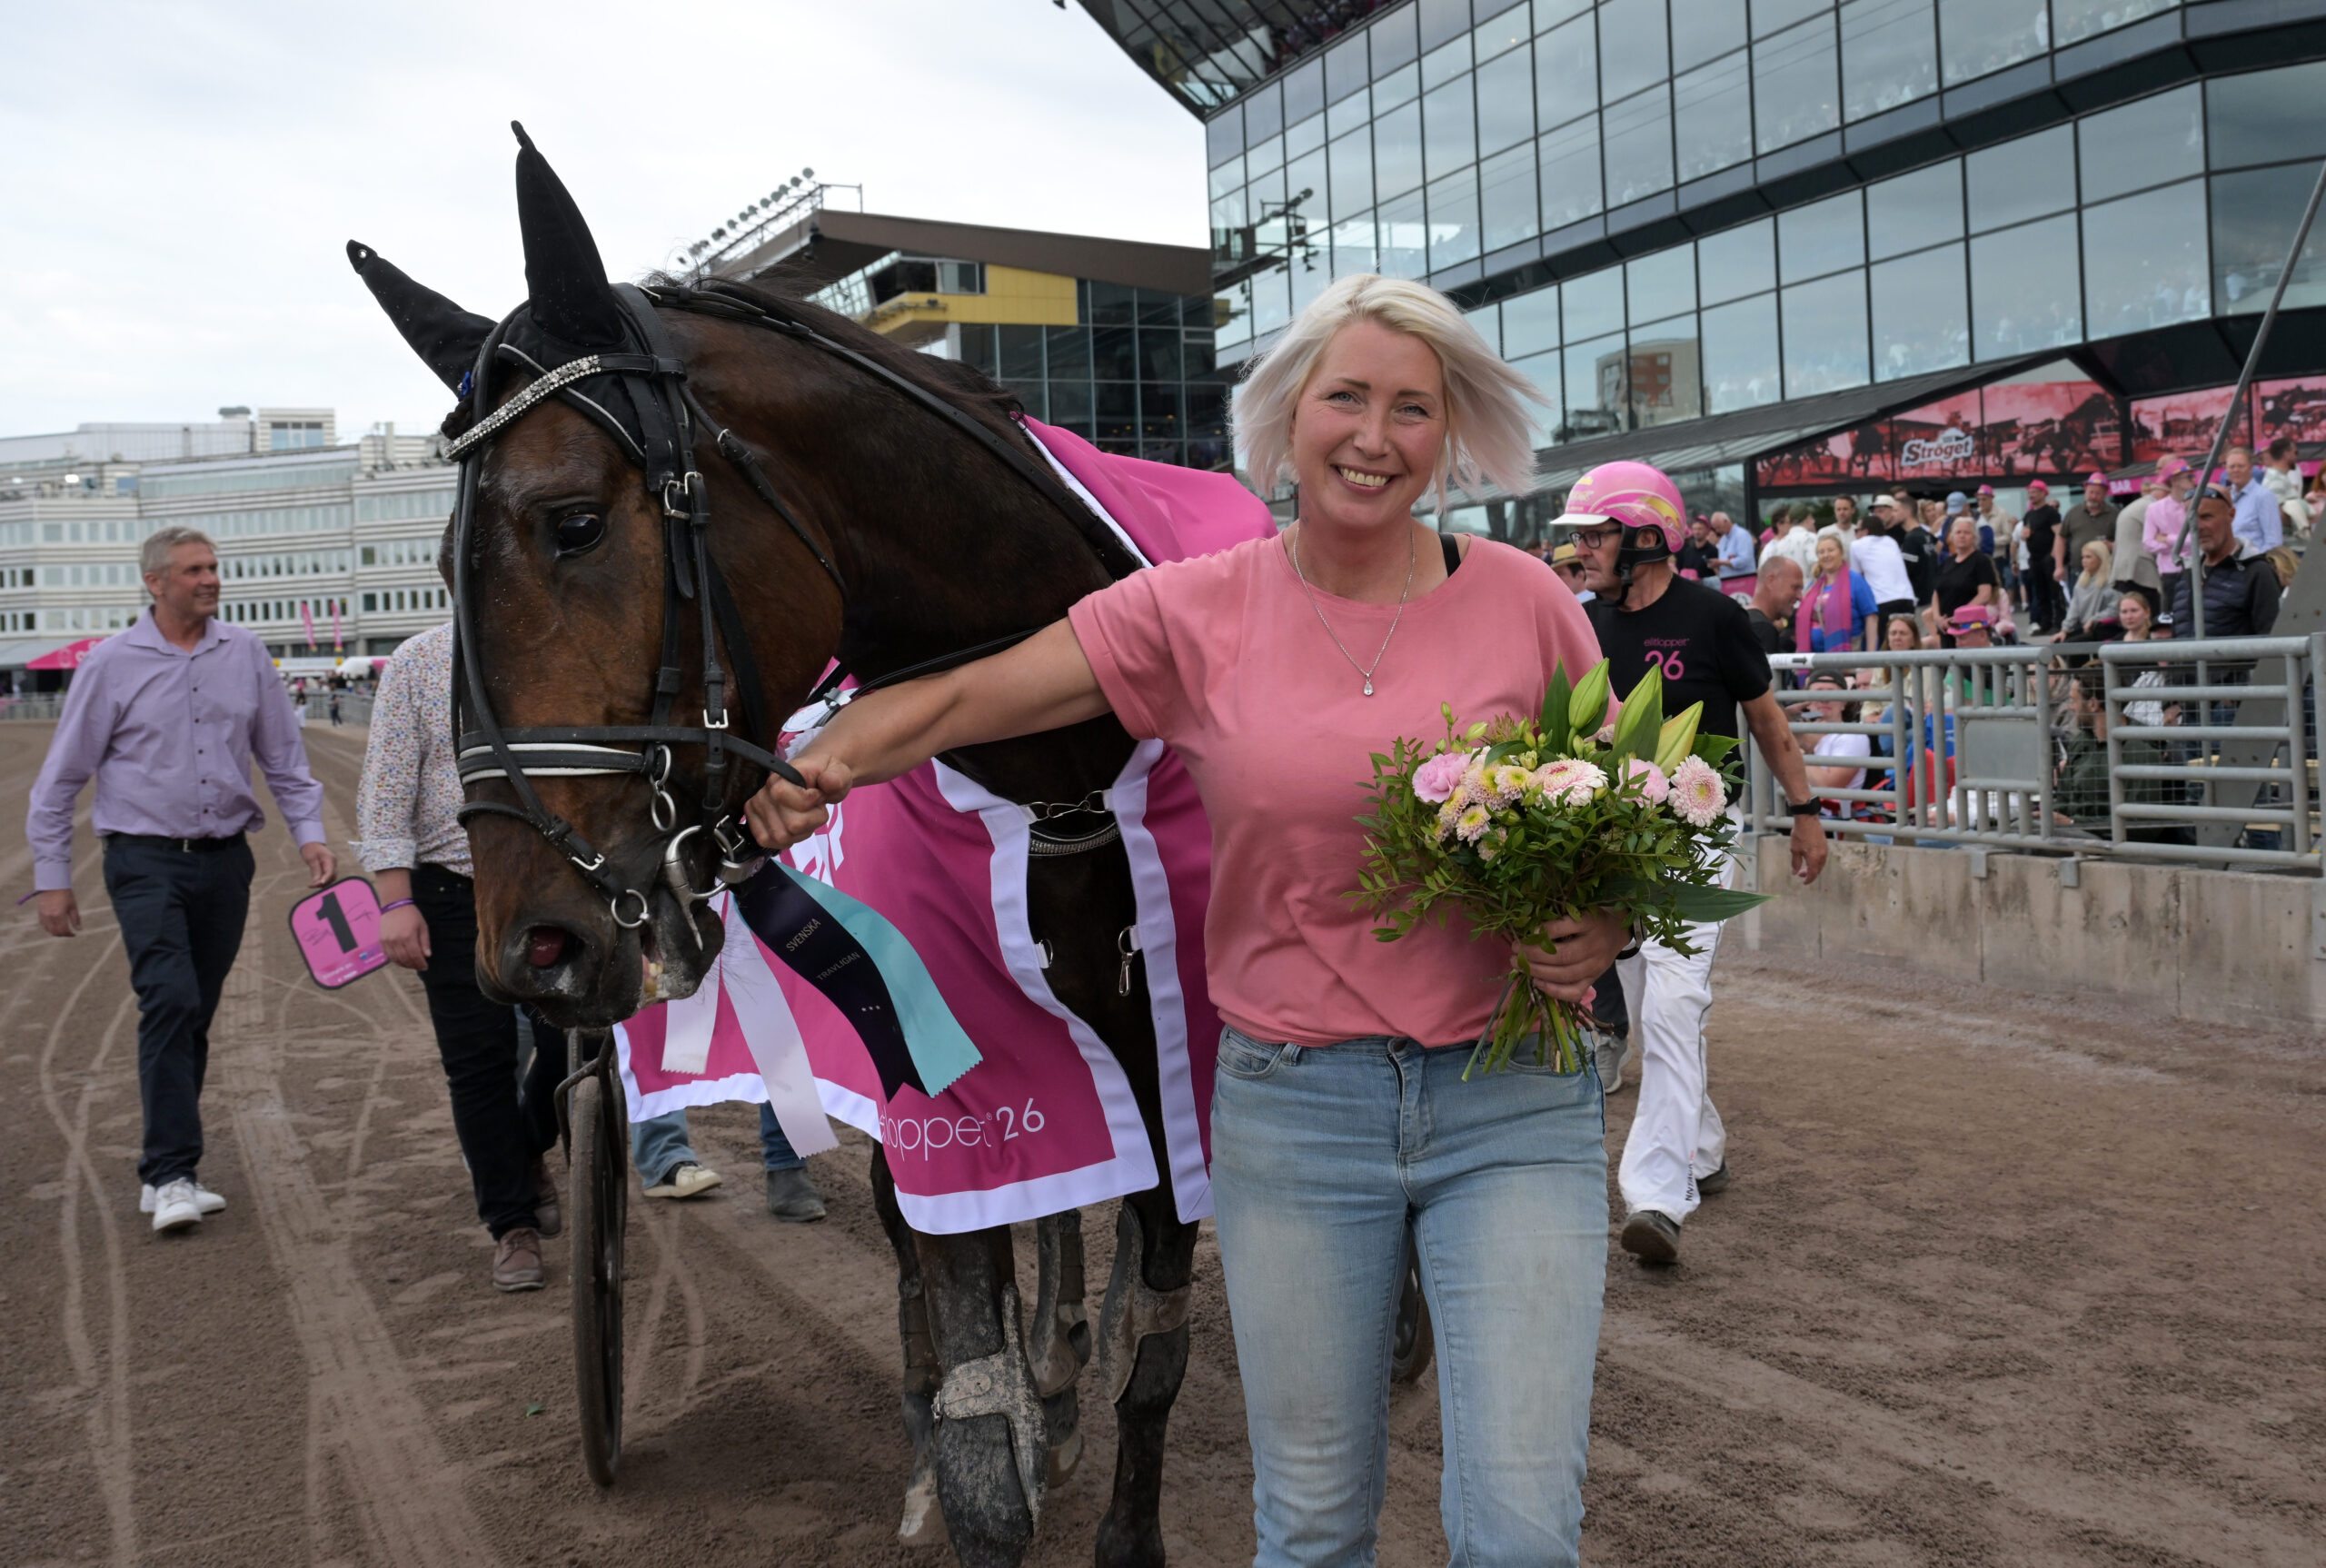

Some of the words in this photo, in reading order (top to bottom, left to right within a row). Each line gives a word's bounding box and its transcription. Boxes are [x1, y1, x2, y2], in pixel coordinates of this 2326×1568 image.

[2110, 479, 2132, 494] BAR
[1645, 650, 1685, 680] 26
[315, 891, 359, 954] 1
[785, 918, 821, 952] SVENSKA
[816, 951, 860, 980] TRAVLIGAN
[996, 1097, 1045, 1142] 26
